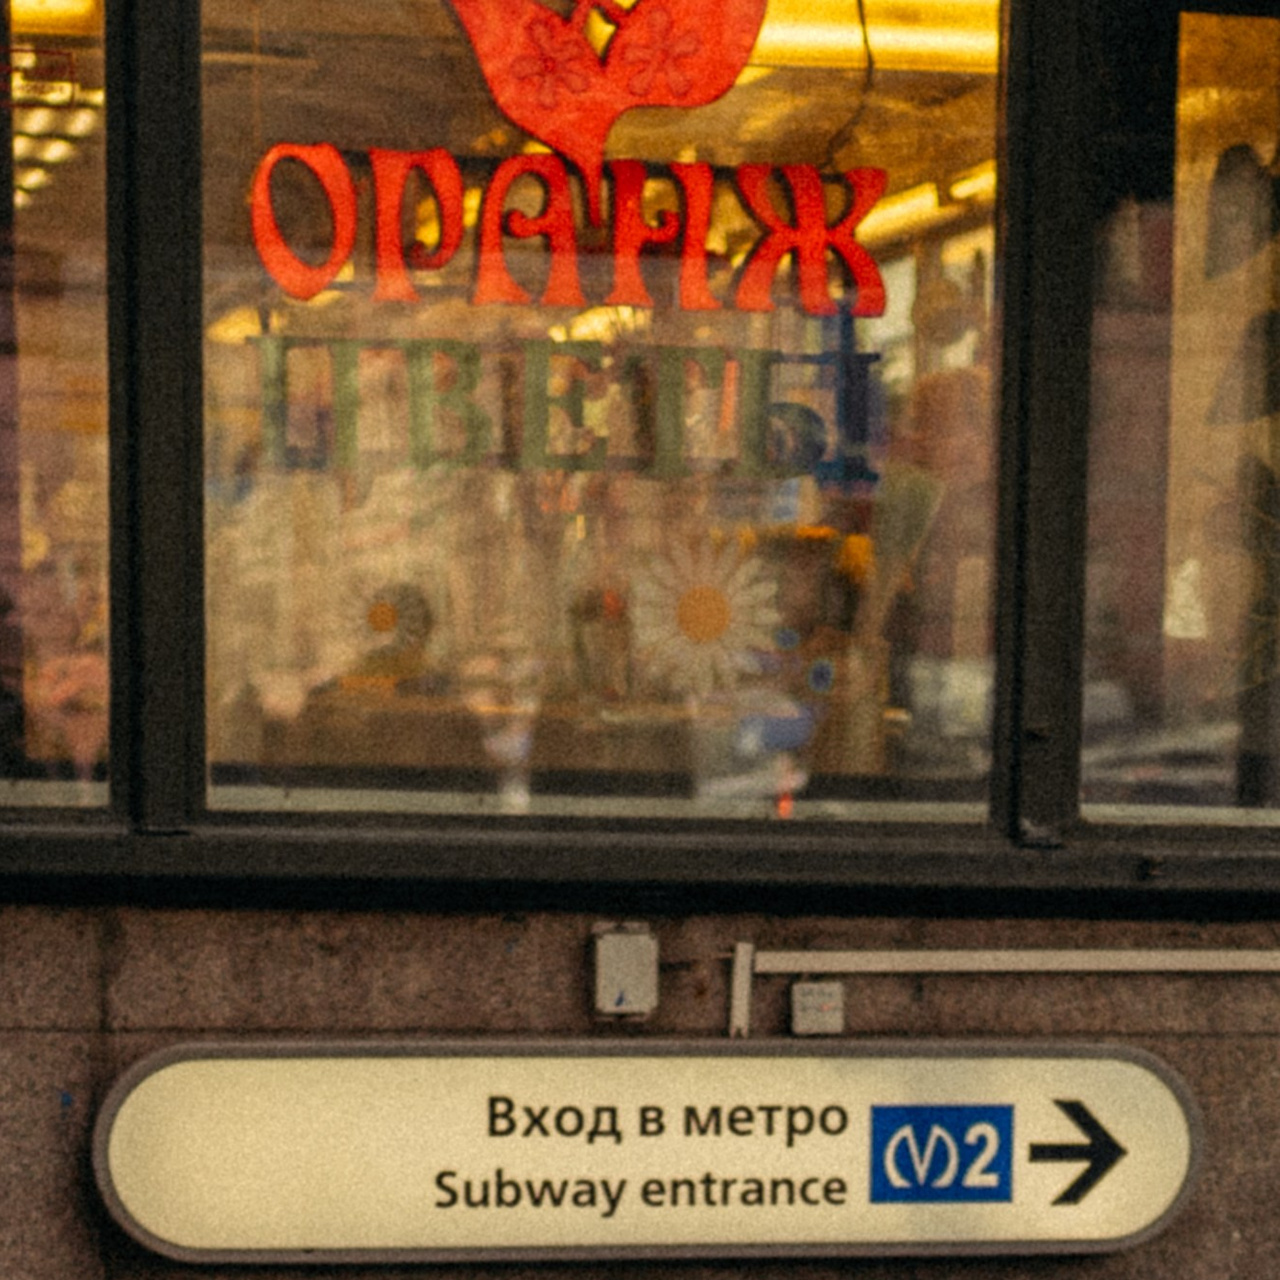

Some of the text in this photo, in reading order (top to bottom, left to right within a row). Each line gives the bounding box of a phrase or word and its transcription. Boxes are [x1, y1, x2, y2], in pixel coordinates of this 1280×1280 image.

[486, 1096, 849, 1146] Вход в метро
[435, 1169, 847, 1217] Subway entrance
